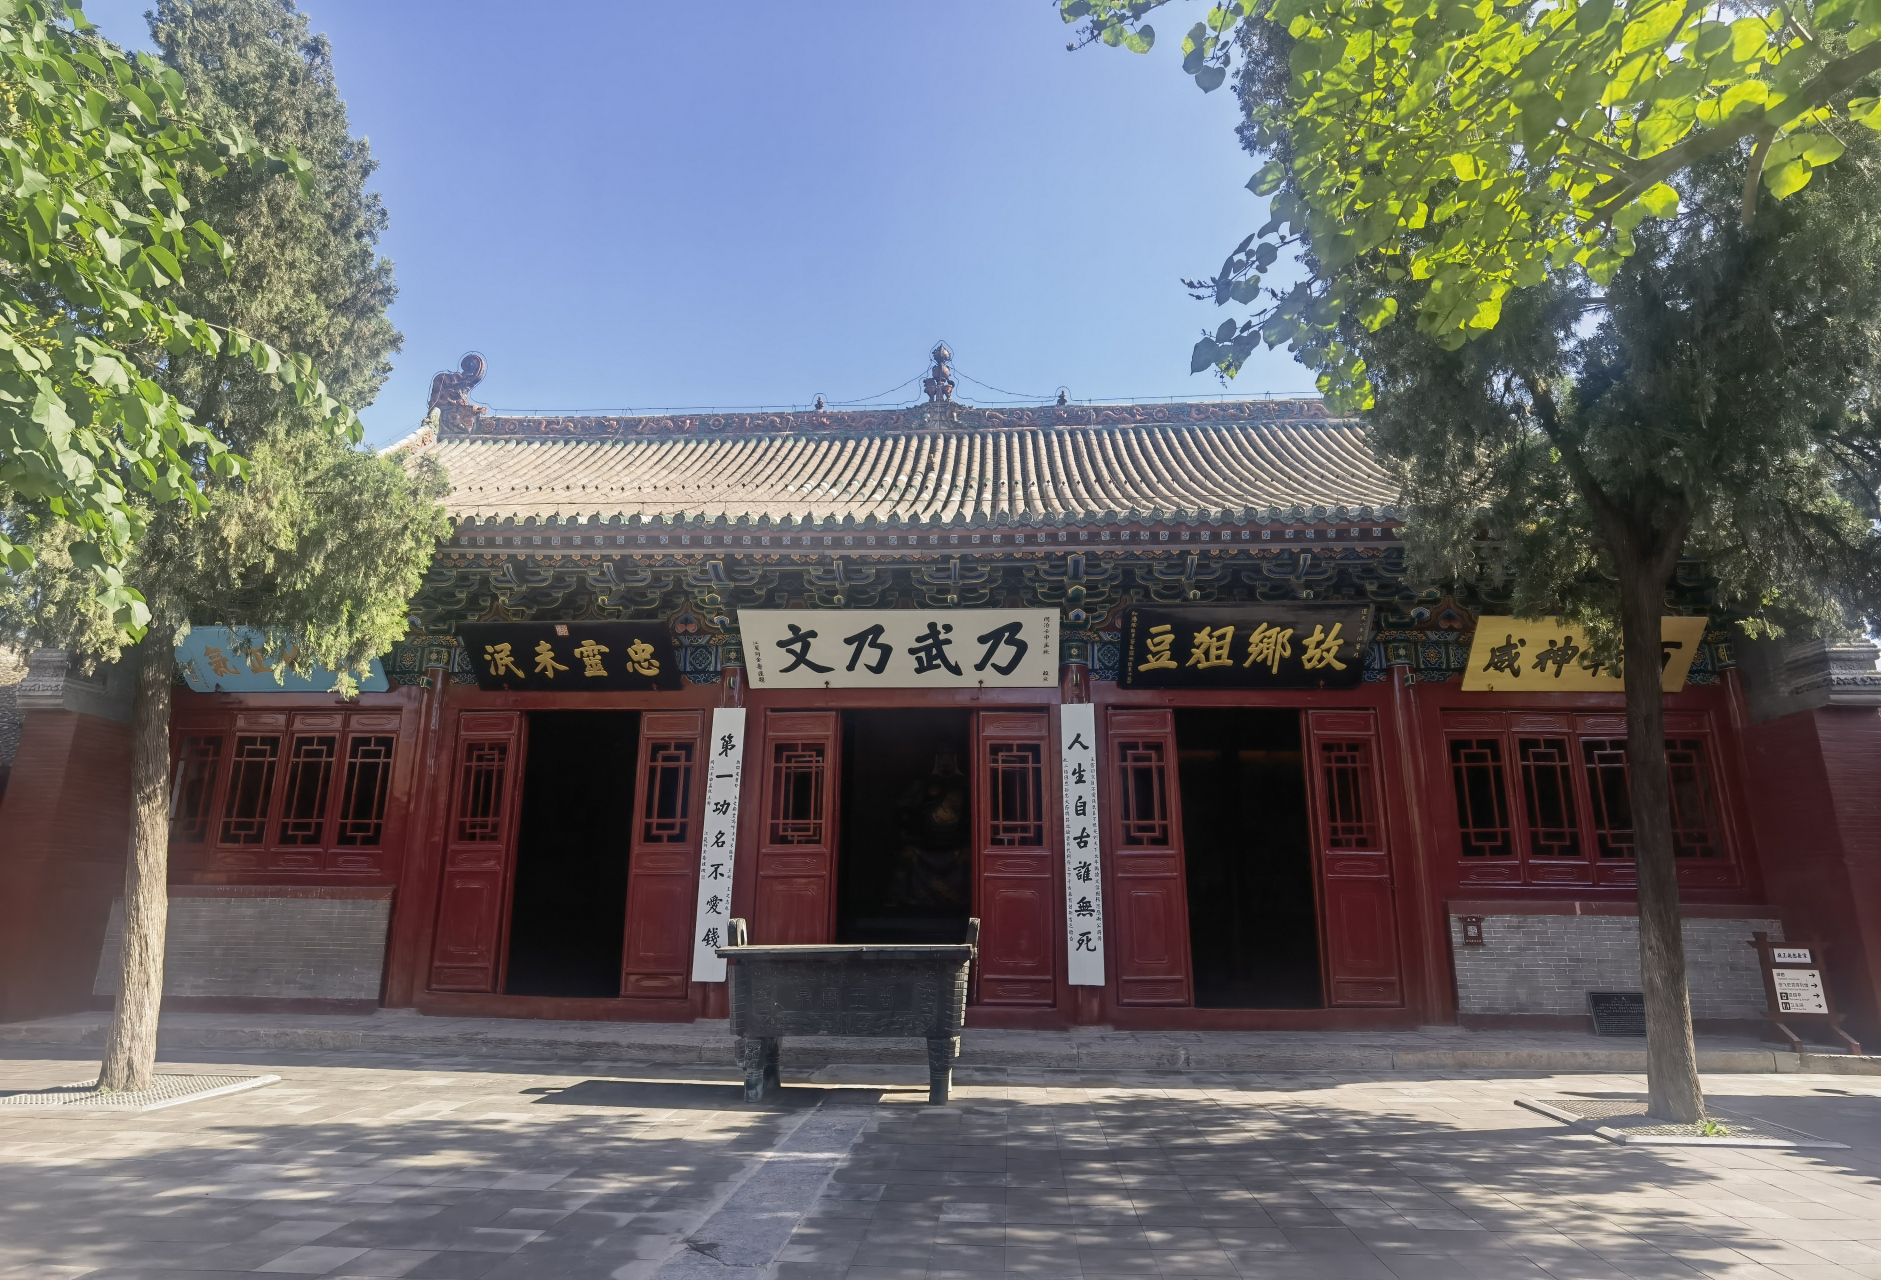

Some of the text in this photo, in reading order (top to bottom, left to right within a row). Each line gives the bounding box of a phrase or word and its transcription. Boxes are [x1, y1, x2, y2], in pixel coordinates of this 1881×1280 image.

[483, 638, 660, 679] 忠靈未泯
[775, 621, 1029, 676] 乃武乃文
[1138, 622, 1348, 675] 故鄉俎豆
[701, 733, 736, 949] 第一功名不愛錢
[1067, 732, 1097, 952] 人生自古誰無死
